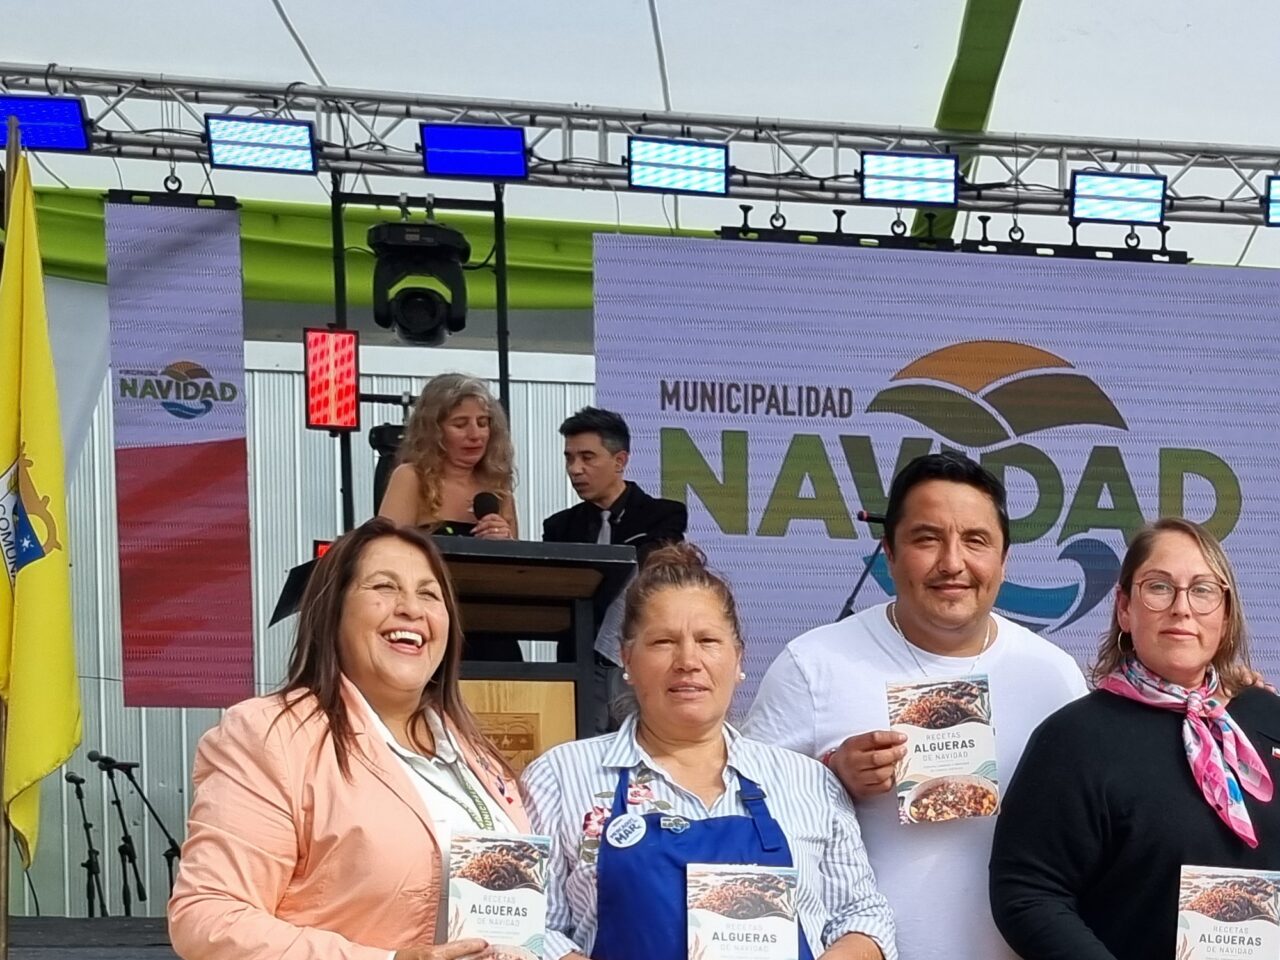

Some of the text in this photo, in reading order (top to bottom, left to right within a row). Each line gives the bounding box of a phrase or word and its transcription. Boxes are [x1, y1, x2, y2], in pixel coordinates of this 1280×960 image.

[120, 378, 238, 402] NAVIDAD
[660, 379, 854, 418] MUNICIPALIDAD
[660, 428, 1243, 548] NAVDAD
[926, 732, 961, 741] RECETAS
[914, 739, 976, 753] ALGUERAS
[935, 751, 969, 761] NAVIDAD
[614, 823, 642, 845] MAR
[470, 903, 528, 917] ALGUERAS
[1213, 925, 1249, 934] RECETAS
[712, 931, 778, 943] ALGUERAS
[1199, 933, 1262, 946] ALGUERAS
[1219, 946, 1254, 956] NAVIDAD
